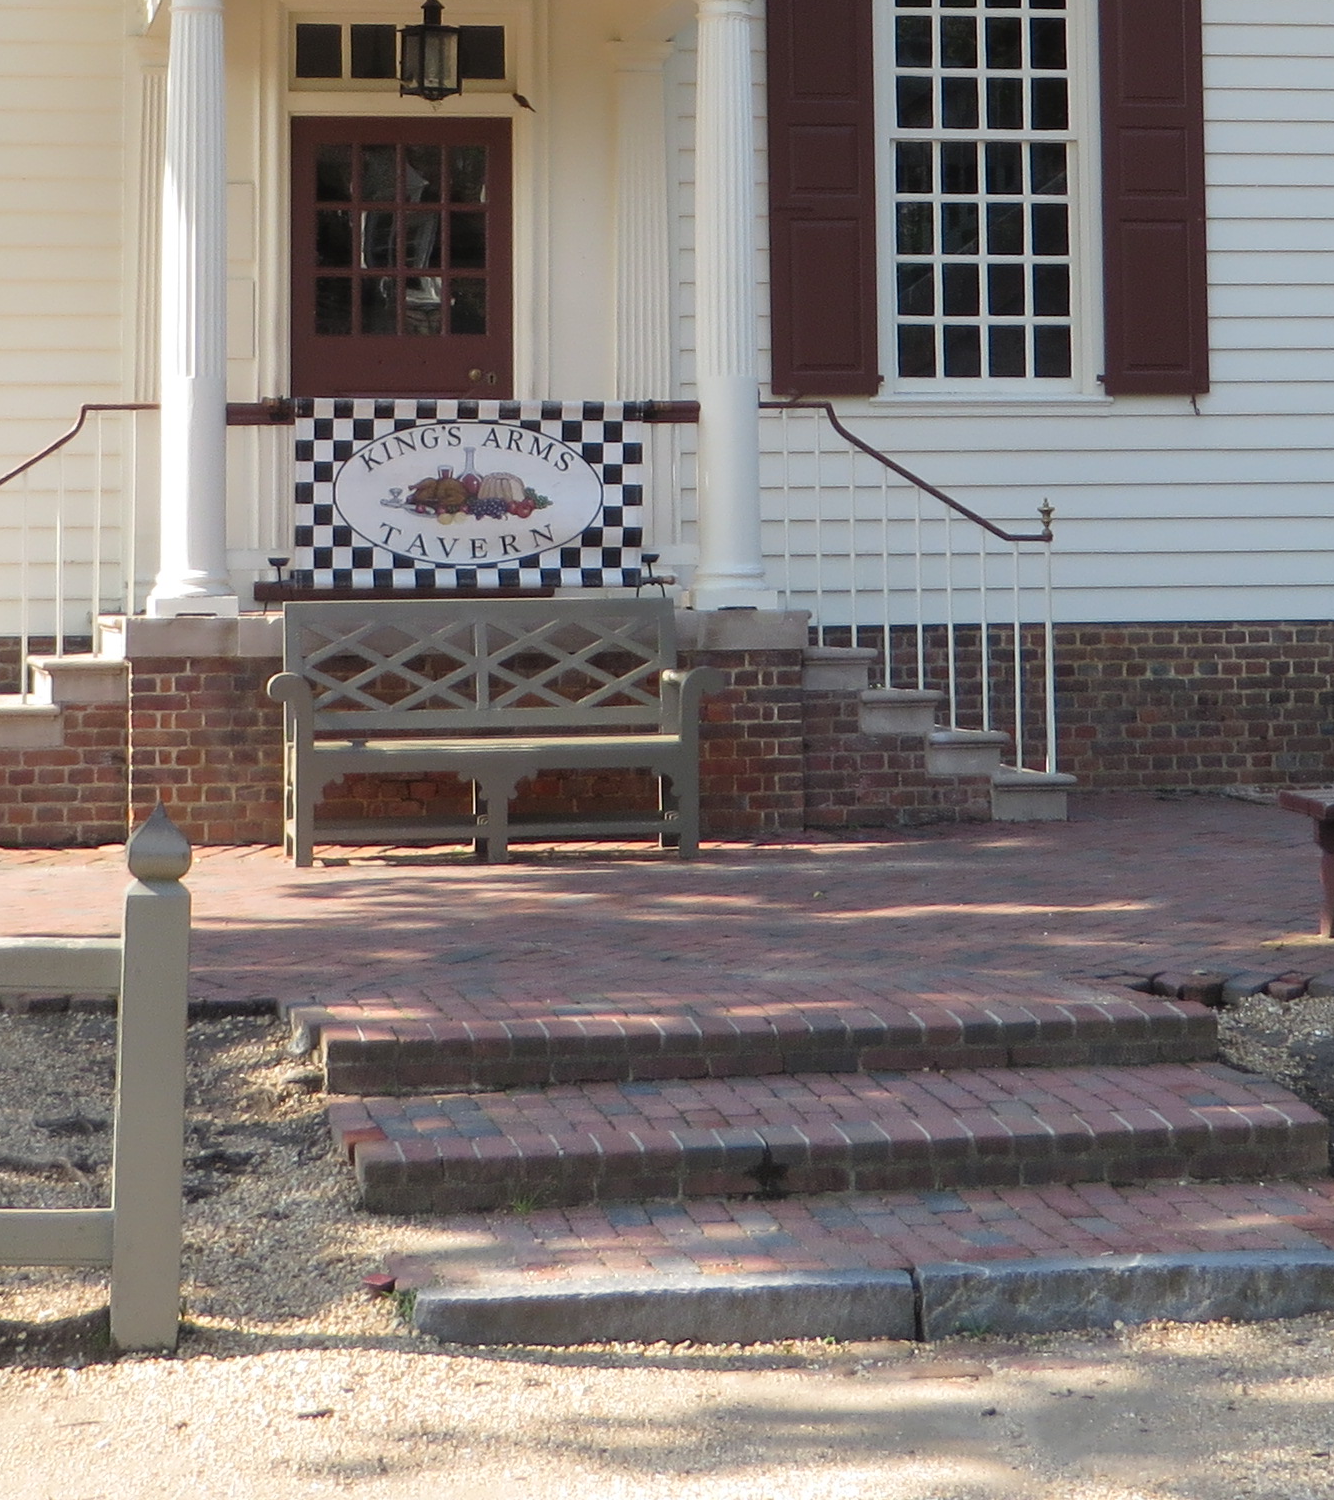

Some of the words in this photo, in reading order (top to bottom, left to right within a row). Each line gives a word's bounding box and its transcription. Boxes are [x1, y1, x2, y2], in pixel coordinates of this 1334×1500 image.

[359, 425, 462, 473] KING'S
[482, 426, 575, 473] ARMS
[379, 522, 555, 560] TAVERN
